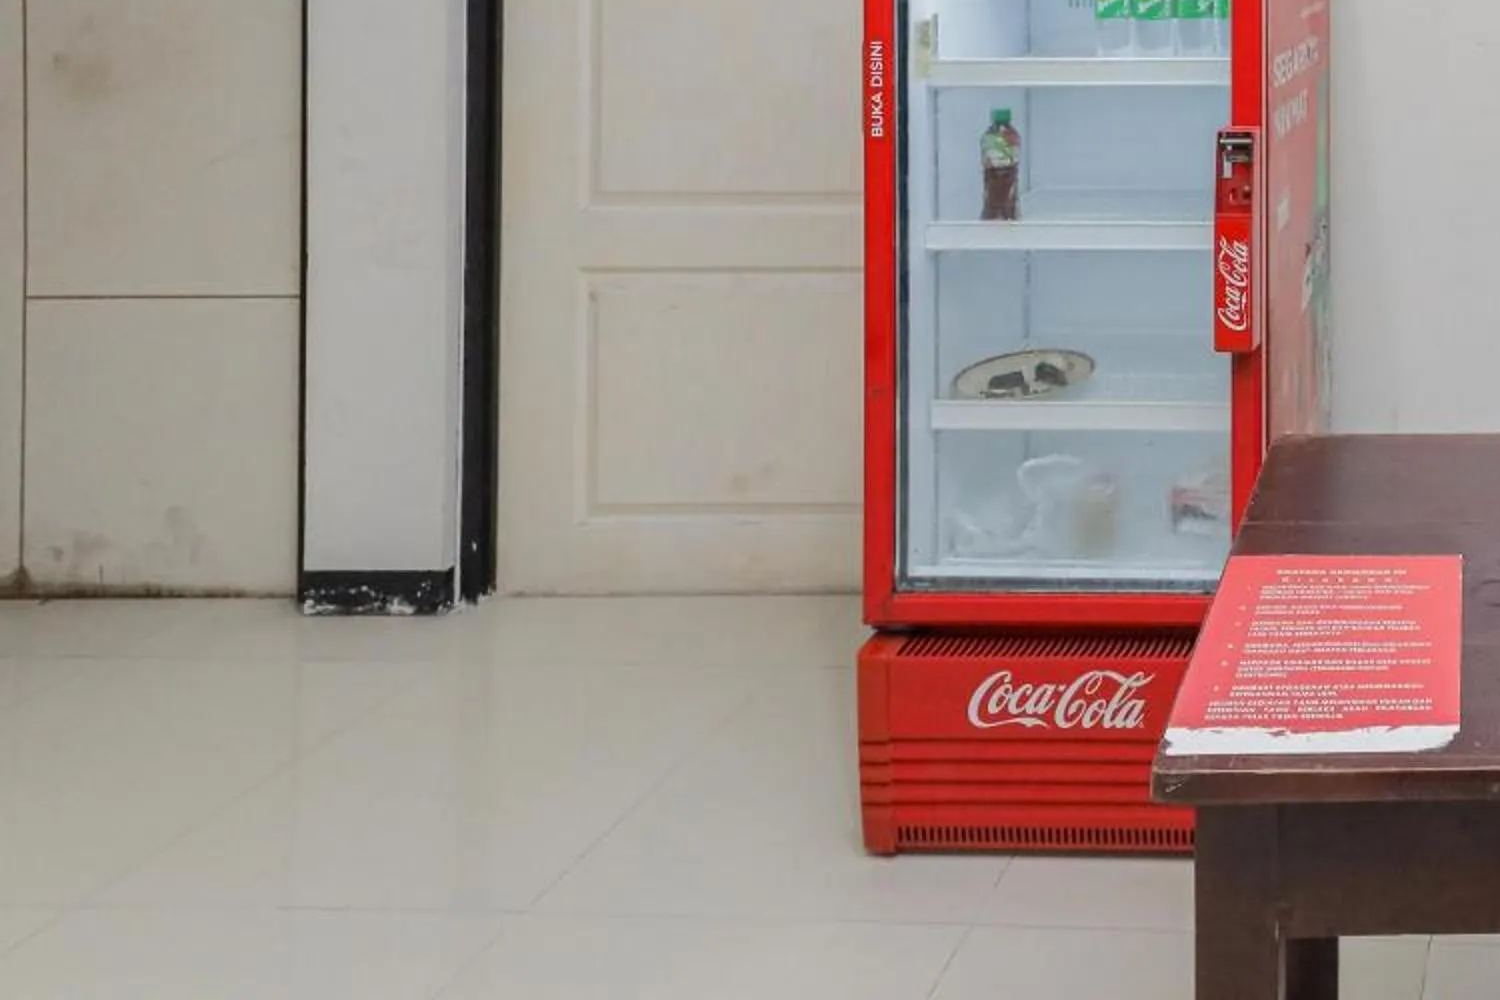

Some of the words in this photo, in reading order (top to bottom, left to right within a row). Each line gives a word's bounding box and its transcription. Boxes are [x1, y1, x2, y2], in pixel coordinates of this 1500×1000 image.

[870, 41, 883, 88] DISINI
[871, 91, 883, 137] BUKA
[1218, 234, 1248, 331] Coca-Cola
[968, 670, 1155, 729] Coca-Cola
